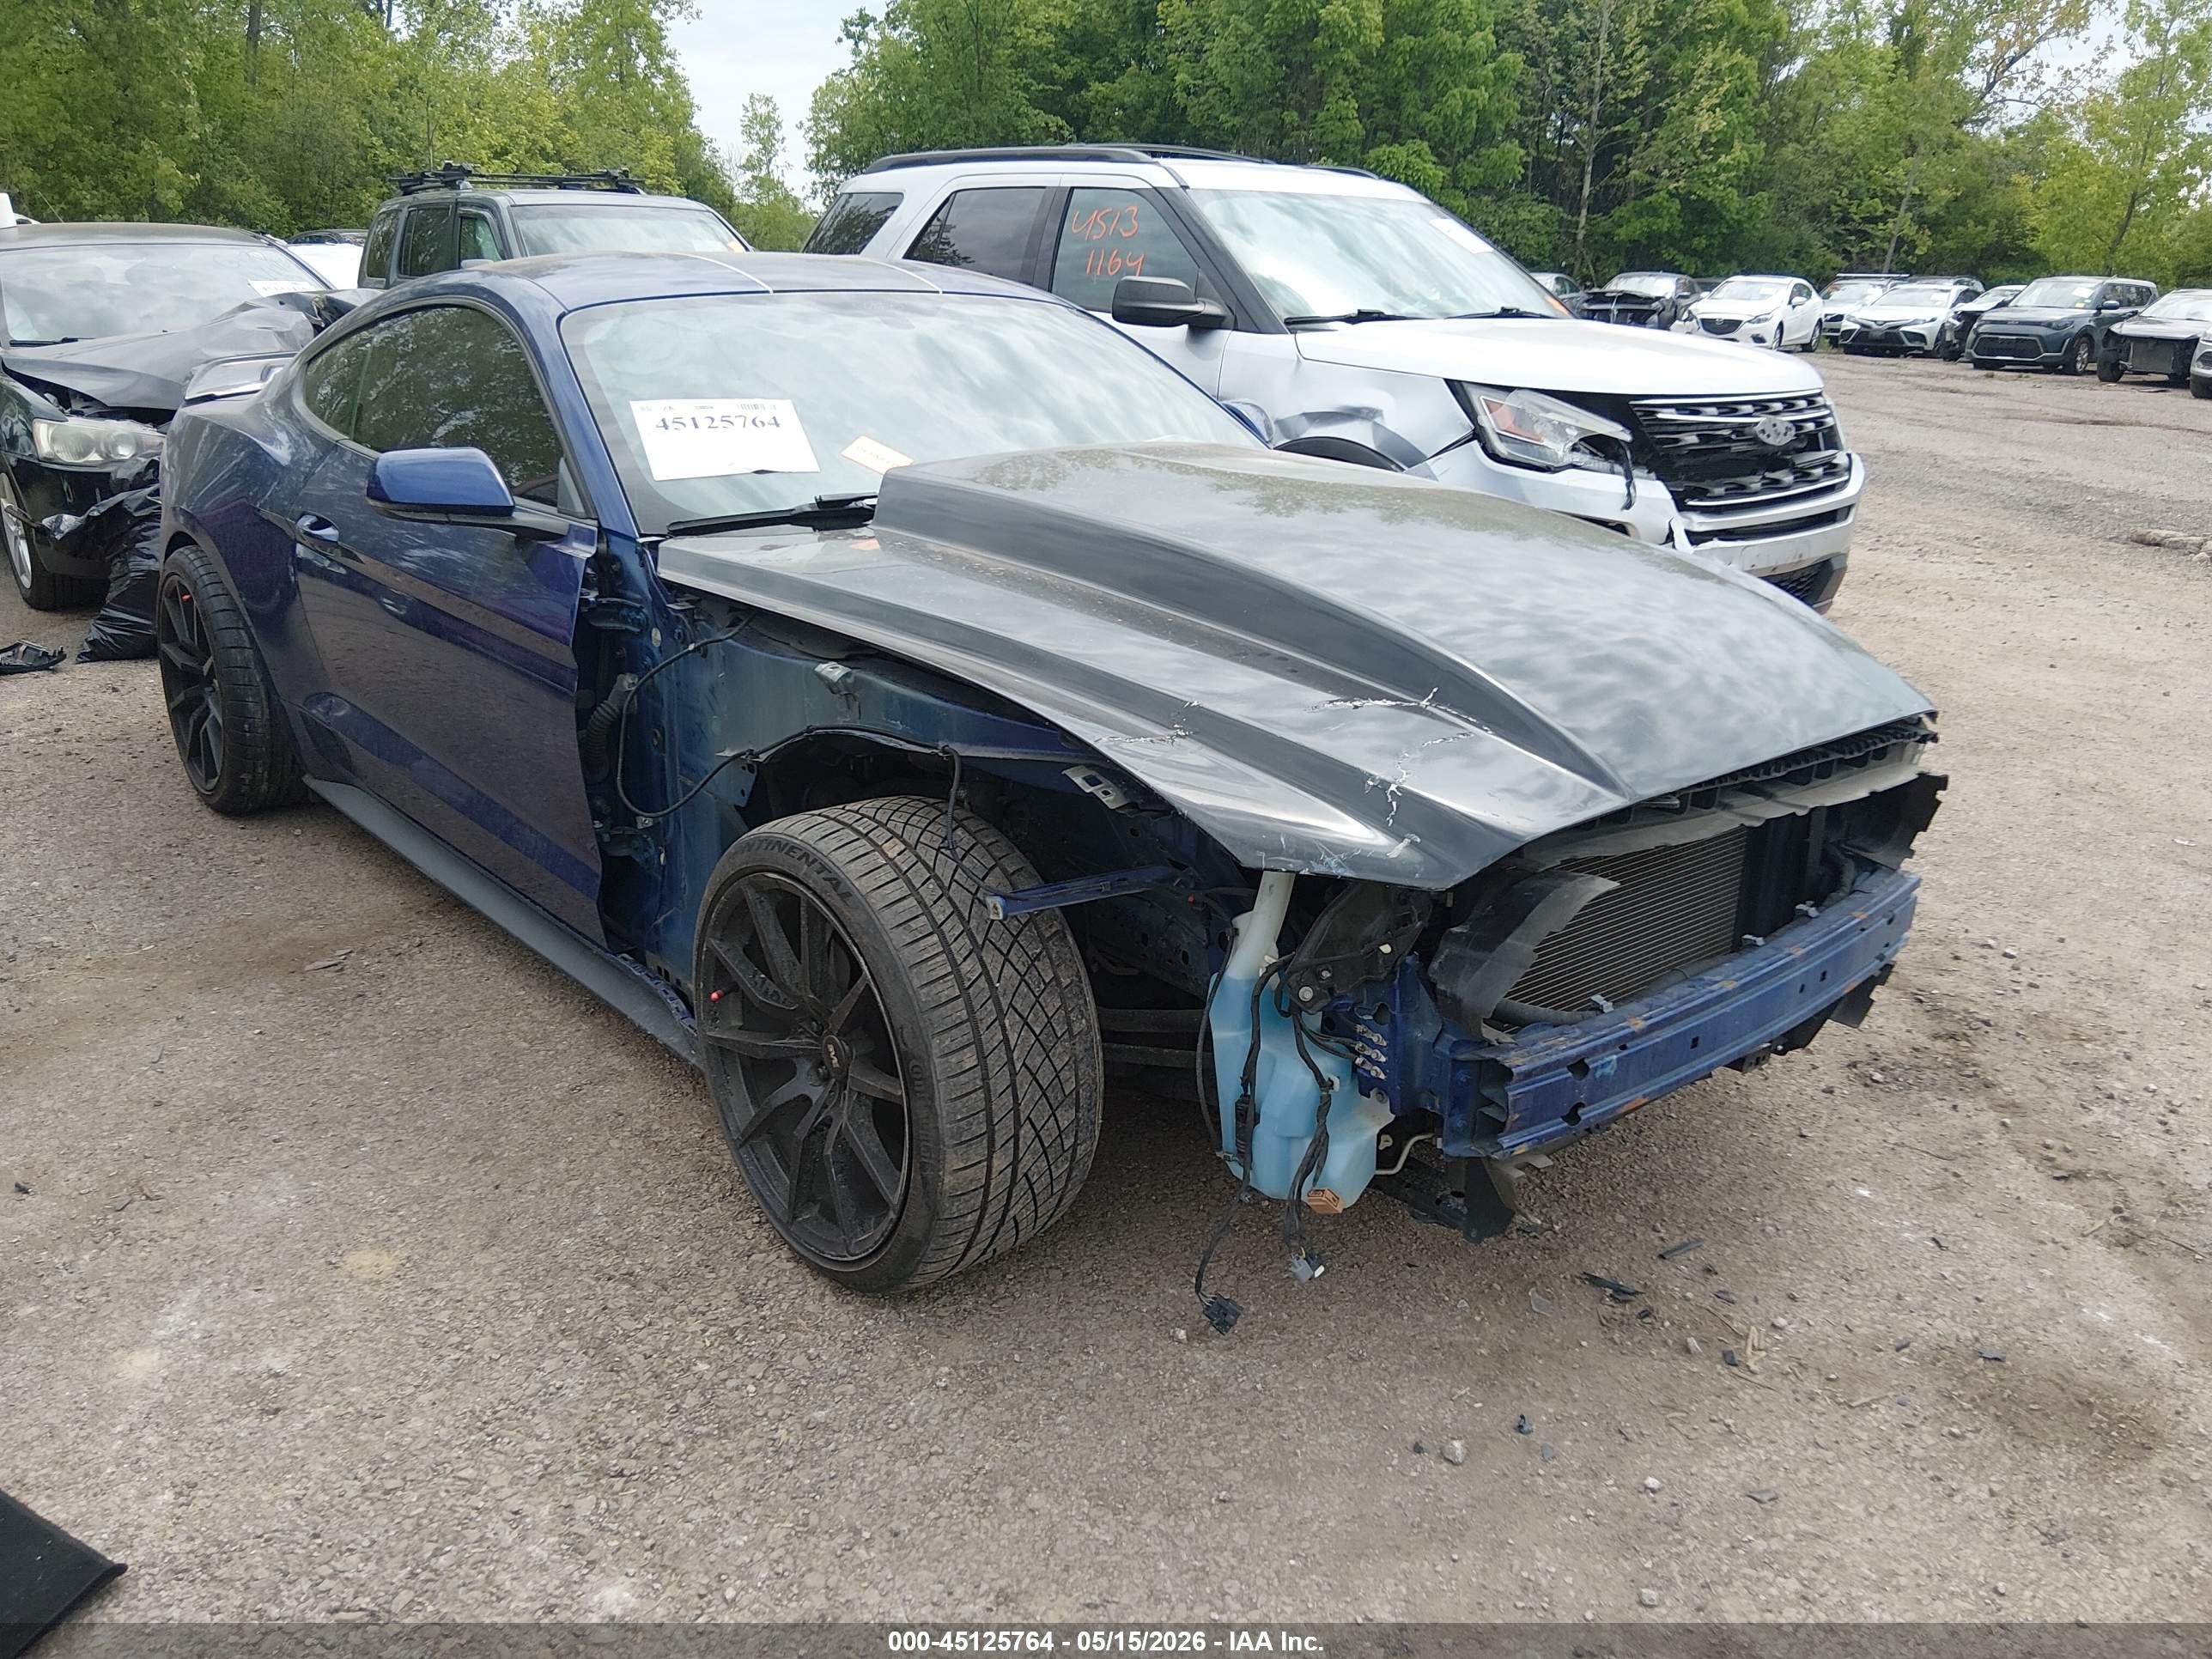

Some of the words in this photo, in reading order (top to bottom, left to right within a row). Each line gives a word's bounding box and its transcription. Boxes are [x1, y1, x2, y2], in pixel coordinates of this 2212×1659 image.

[1086, 248, 1146, 276] 1164
[655, 415, 781, 430] 45125764
[738, 838, 854, 906] NTINENTAL
